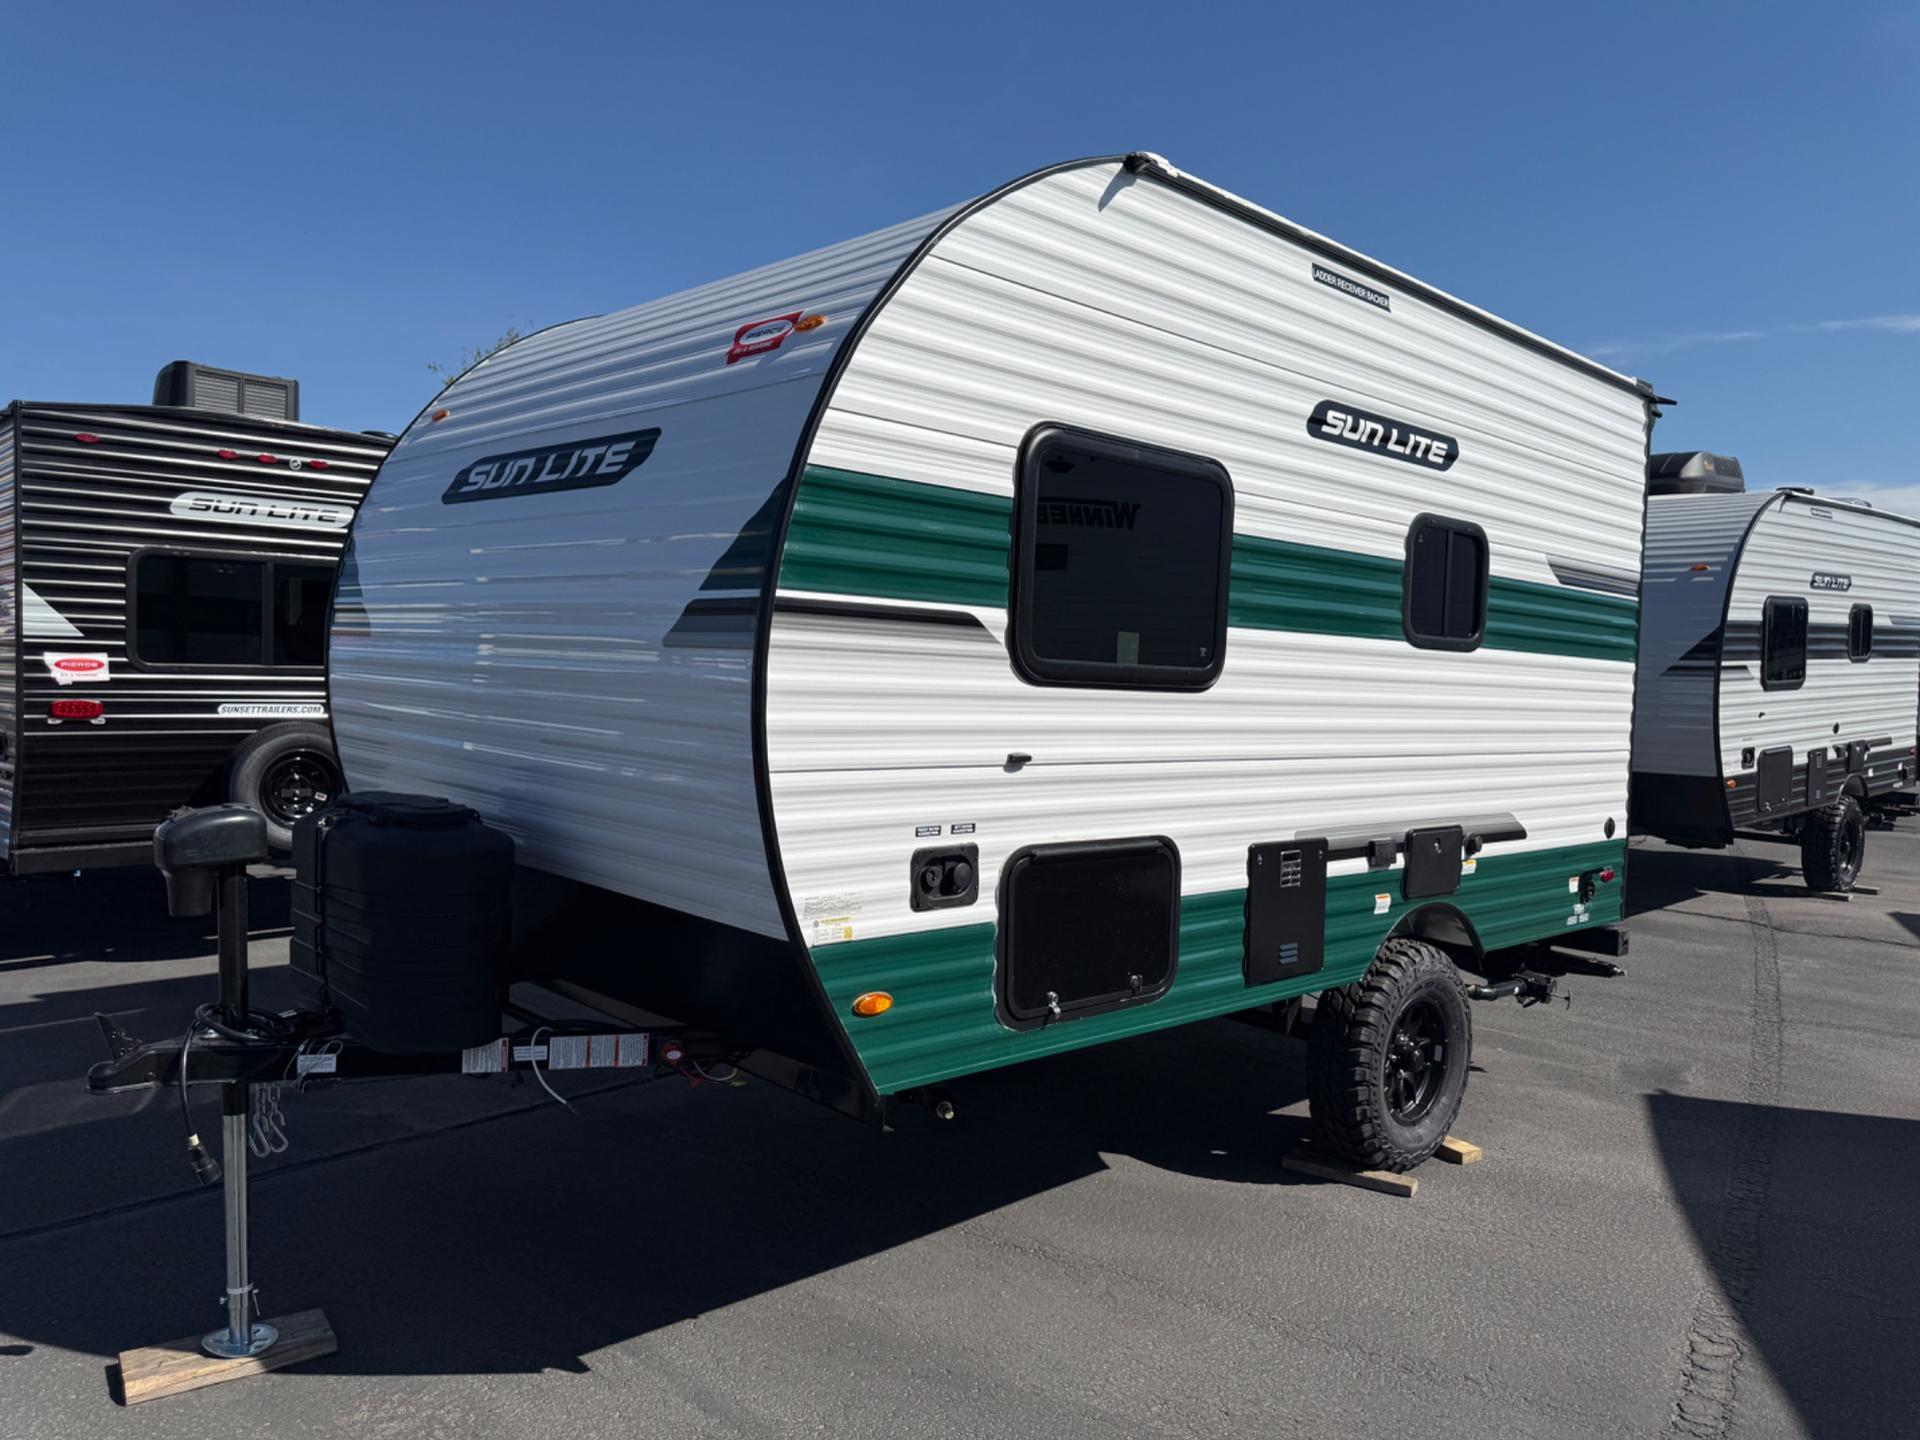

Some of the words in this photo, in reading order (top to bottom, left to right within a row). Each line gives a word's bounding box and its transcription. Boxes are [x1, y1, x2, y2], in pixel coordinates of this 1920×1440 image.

[1312, 269, 1337, 286] LADDER
[1337, 278, 1367, 299] RECEIVER
[1321, 409, 1385, 447] SUN
[1386, 427, 1449, 465] LITE
[458, 456, 537, 493] SUN
[533, 440, 637, 484] LITE
[188, 497, 259, 516] SUN
[266, 504, 340, 523] LITE
[220, 704, 322, 715] SUNSETTRAILERS.COM
